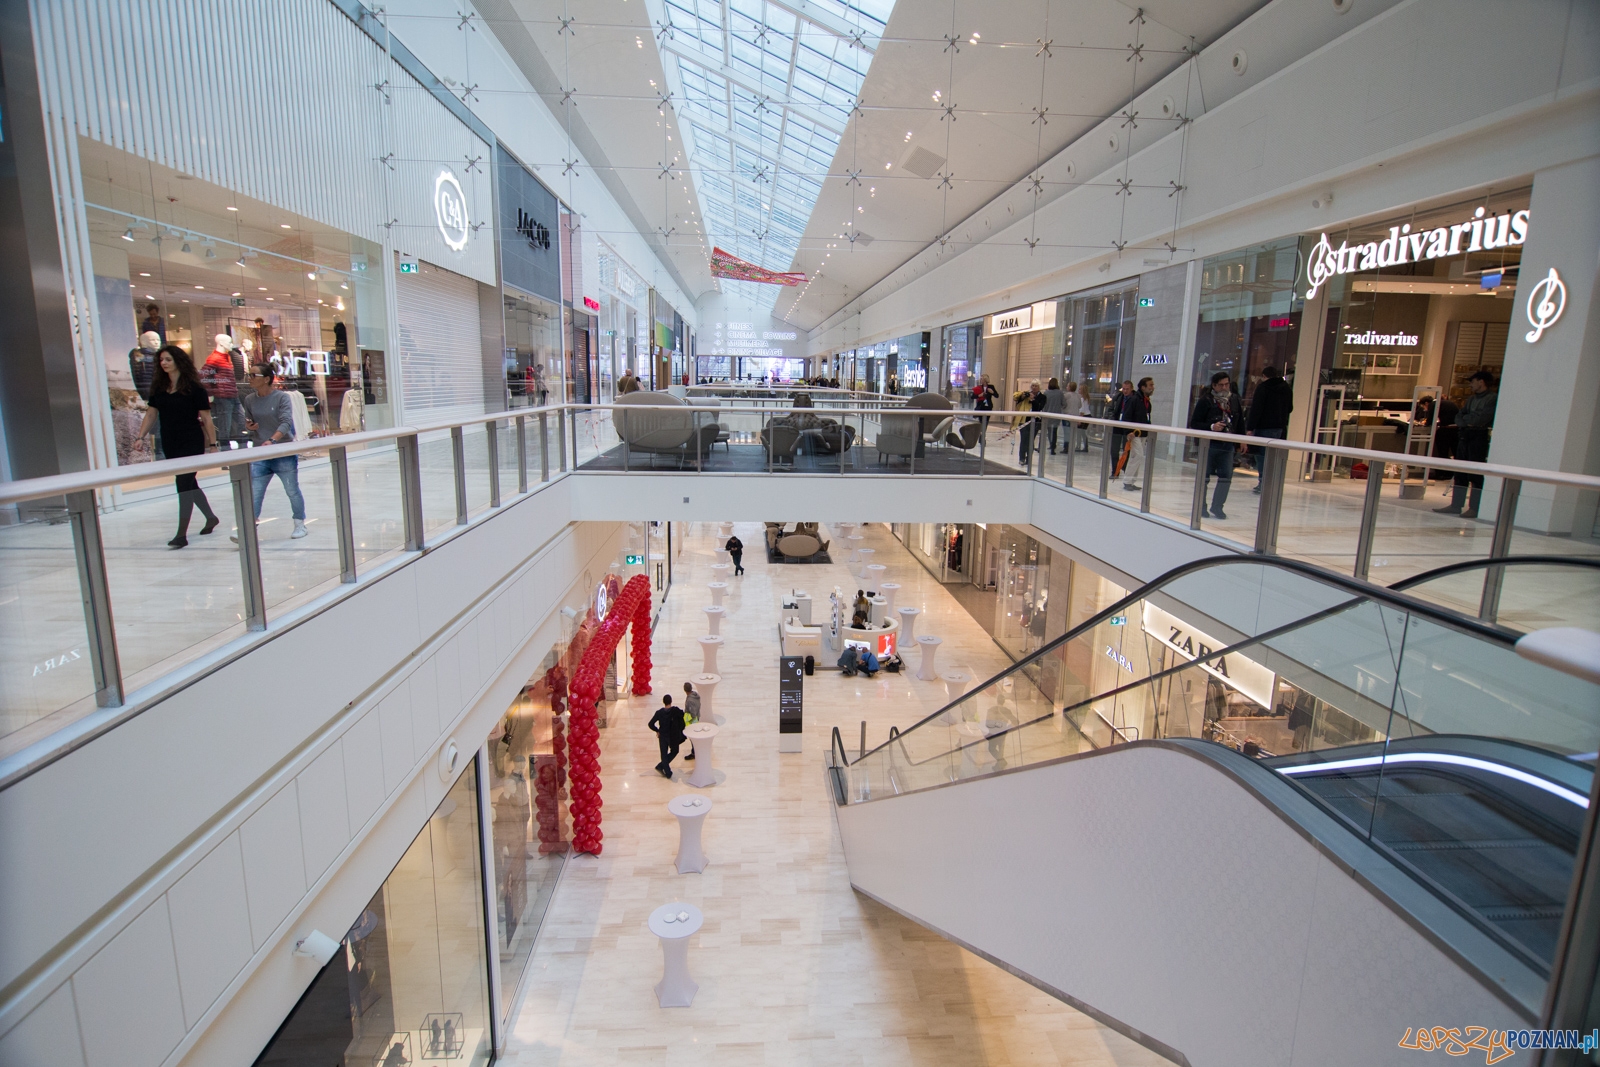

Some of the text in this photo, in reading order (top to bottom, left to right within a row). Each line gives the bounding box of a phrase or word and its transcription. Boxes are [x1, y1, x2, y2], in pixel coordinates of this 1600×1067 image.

[441, 191, 464, 232] C&A
[1325, 207, 1530, 276] stradivarius
[727, 331, 797, 340] CINEMA BOWLING
[1000, 317, 1019, 330] ZARA
[1142, 354, 1167, 365] ZARA
[904, 364, 925, 388] Bershka
[1106, 645, 1133, 673] ZARA
[1168, 625, 1230, 678] ZARA
